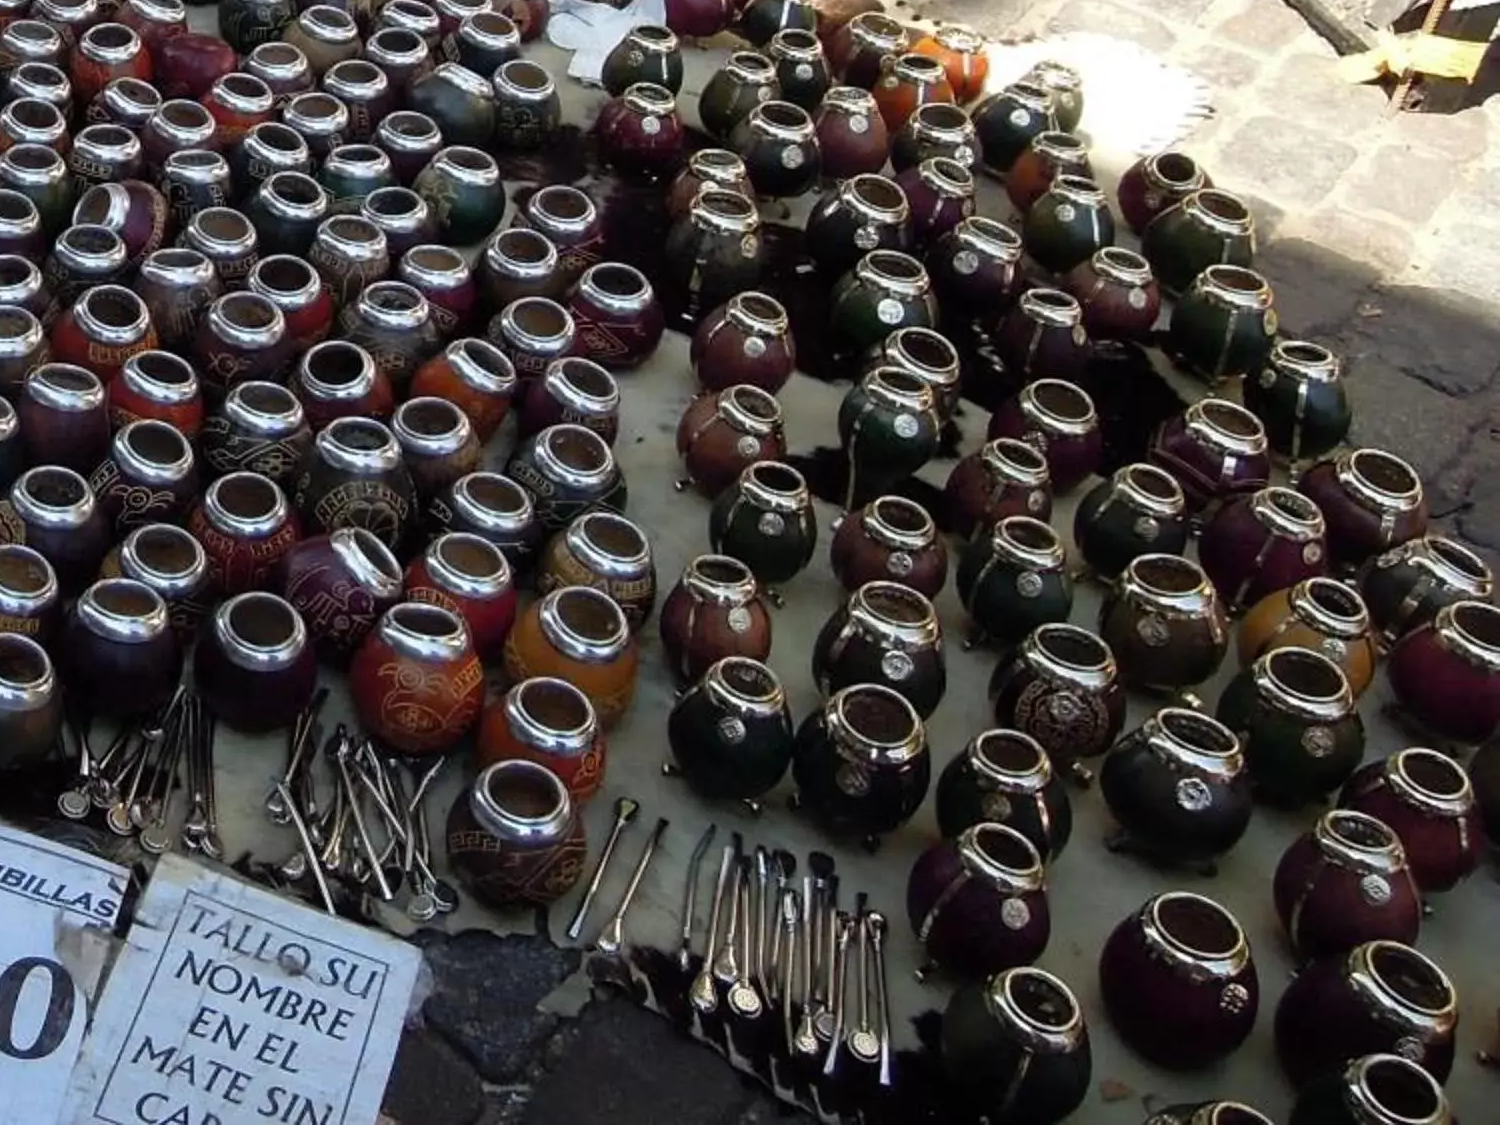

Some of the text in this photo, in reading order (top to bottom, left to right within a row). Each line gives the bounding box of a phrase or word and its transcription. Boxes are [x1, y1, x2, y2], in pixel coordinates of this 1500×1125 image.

[175, 950, 354, 1042] NOMBRE
[185, 904, 381, 1000] TALLO SU
[131, 1036, 333, 1125] MATE SIN
[188, 1008, 299, 1074] EN EL
